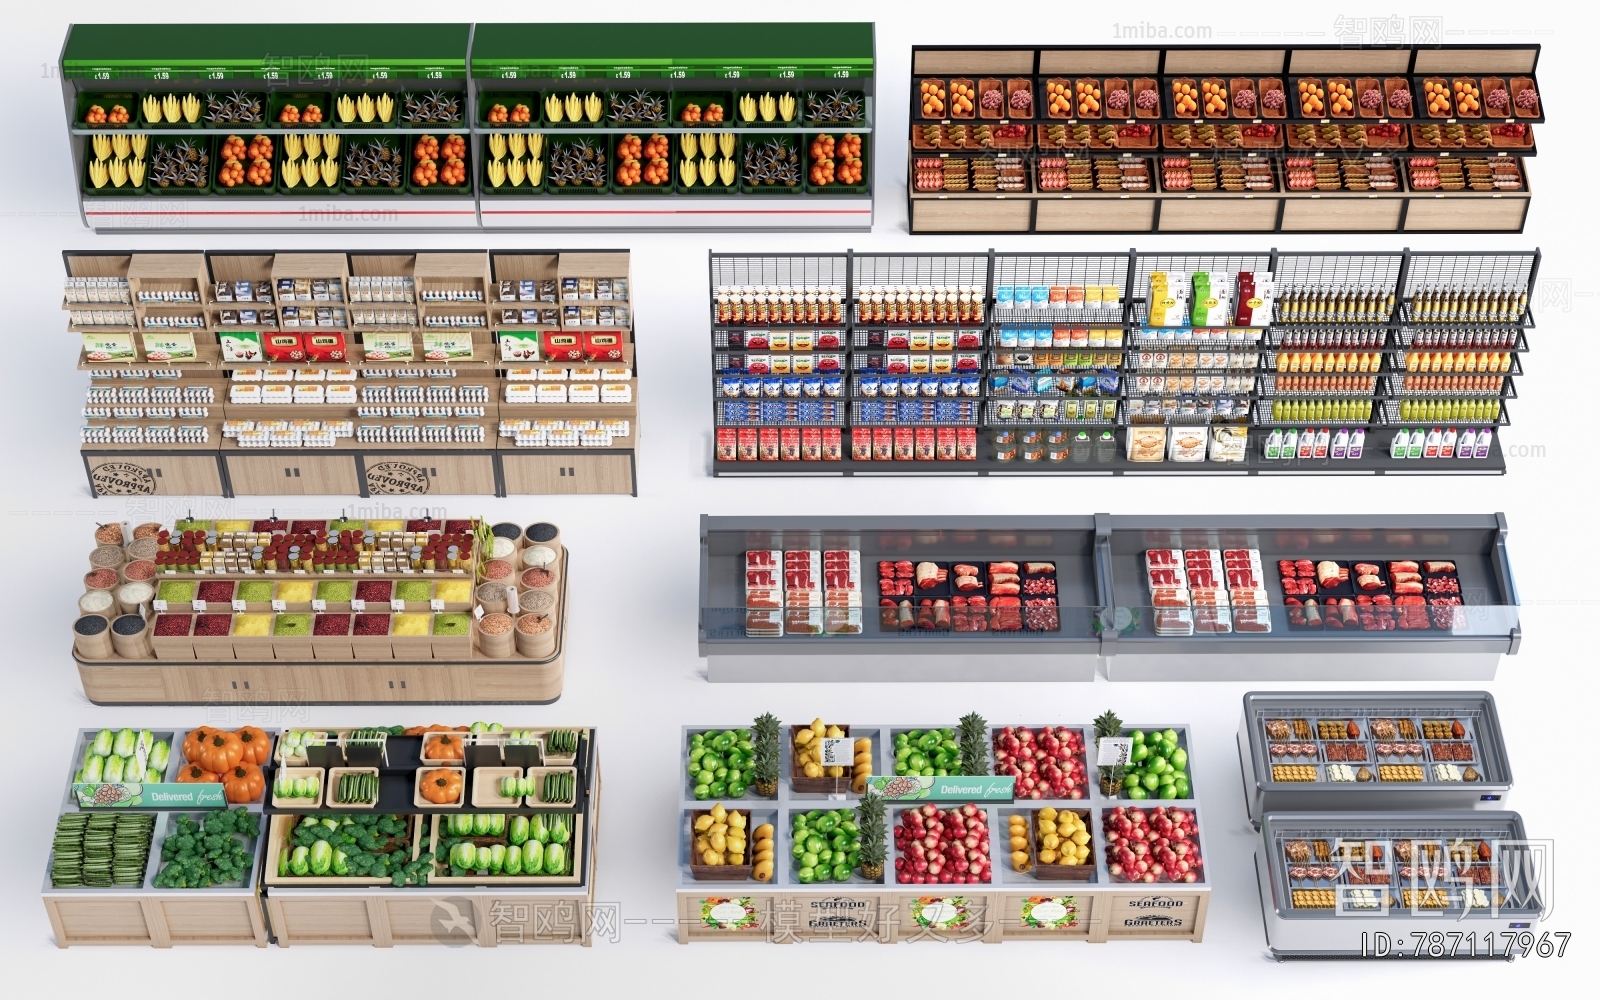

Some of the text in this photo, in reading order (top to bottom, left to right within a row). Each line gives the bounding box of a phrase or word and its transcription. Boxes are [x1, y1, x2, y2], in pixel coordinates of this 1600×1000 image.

[151, 789, 223, 805] Delivered fresh
[940, 782, 1013, 798] Delivered fresh
